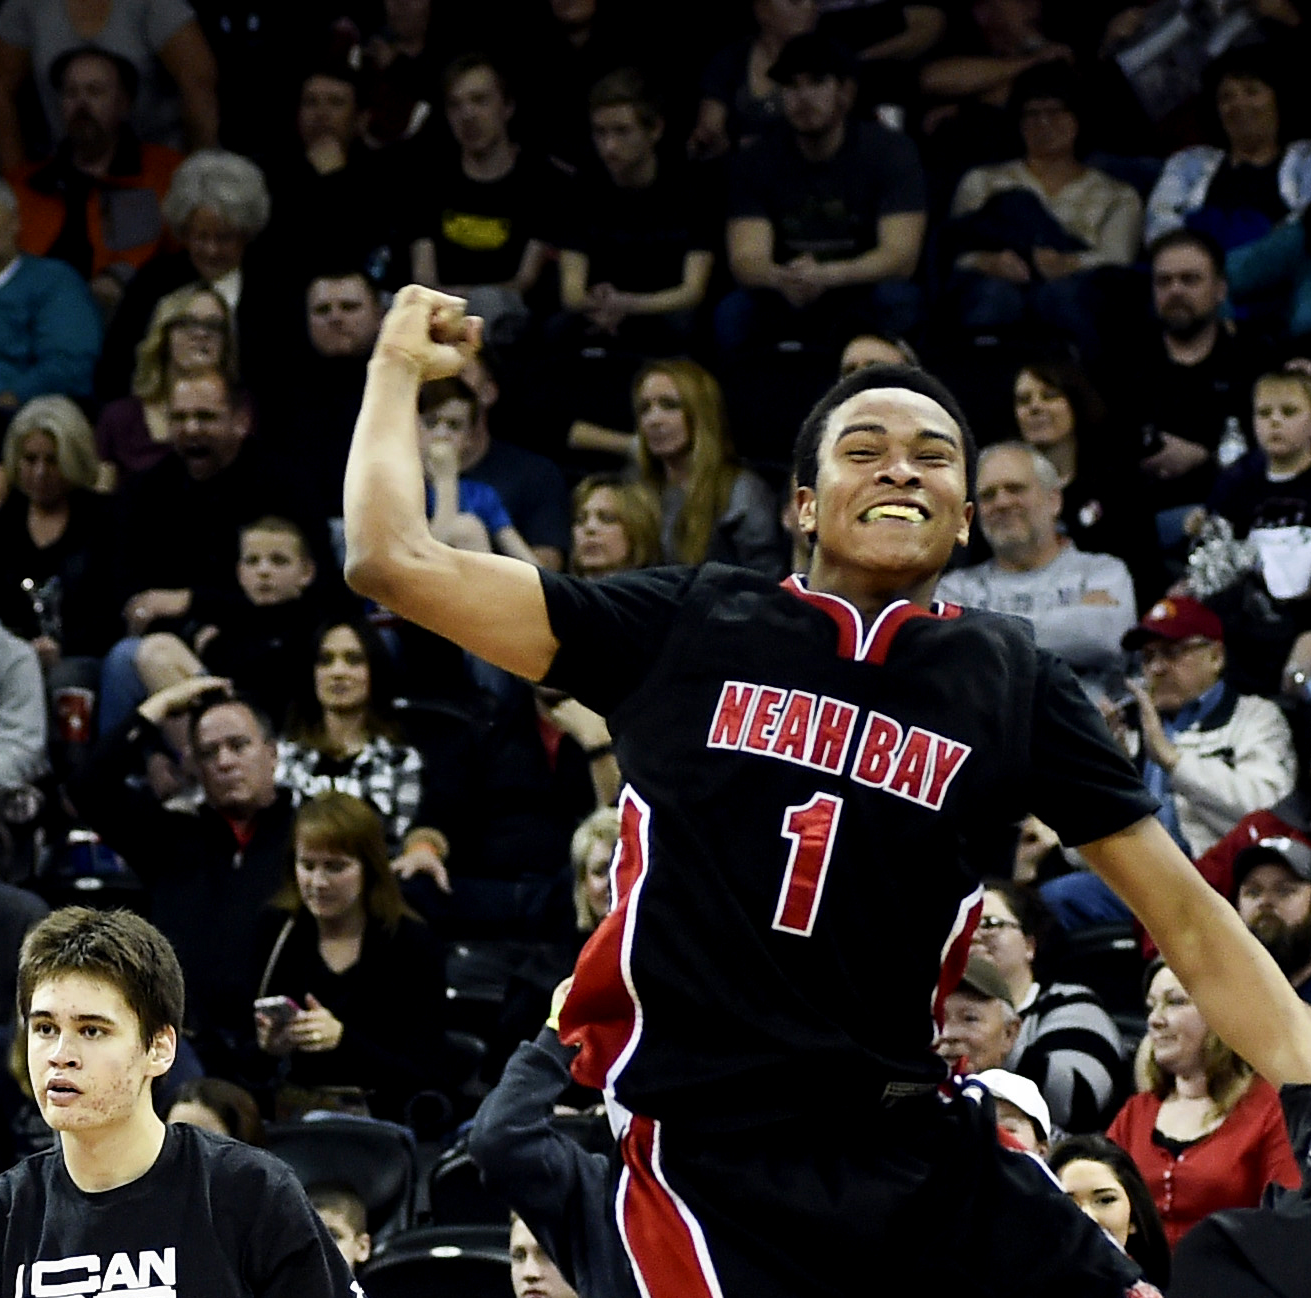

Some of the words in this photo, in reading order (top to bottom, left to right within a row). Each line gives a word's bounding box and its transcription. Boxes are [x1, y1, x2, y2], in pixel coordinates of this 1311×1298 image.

[706, 680, 860, 776] NEAH
[849, 709, 972, 812] BAY
[771, 791, 844, 937] 1
[31, 1246, 177, 1298] CAN
